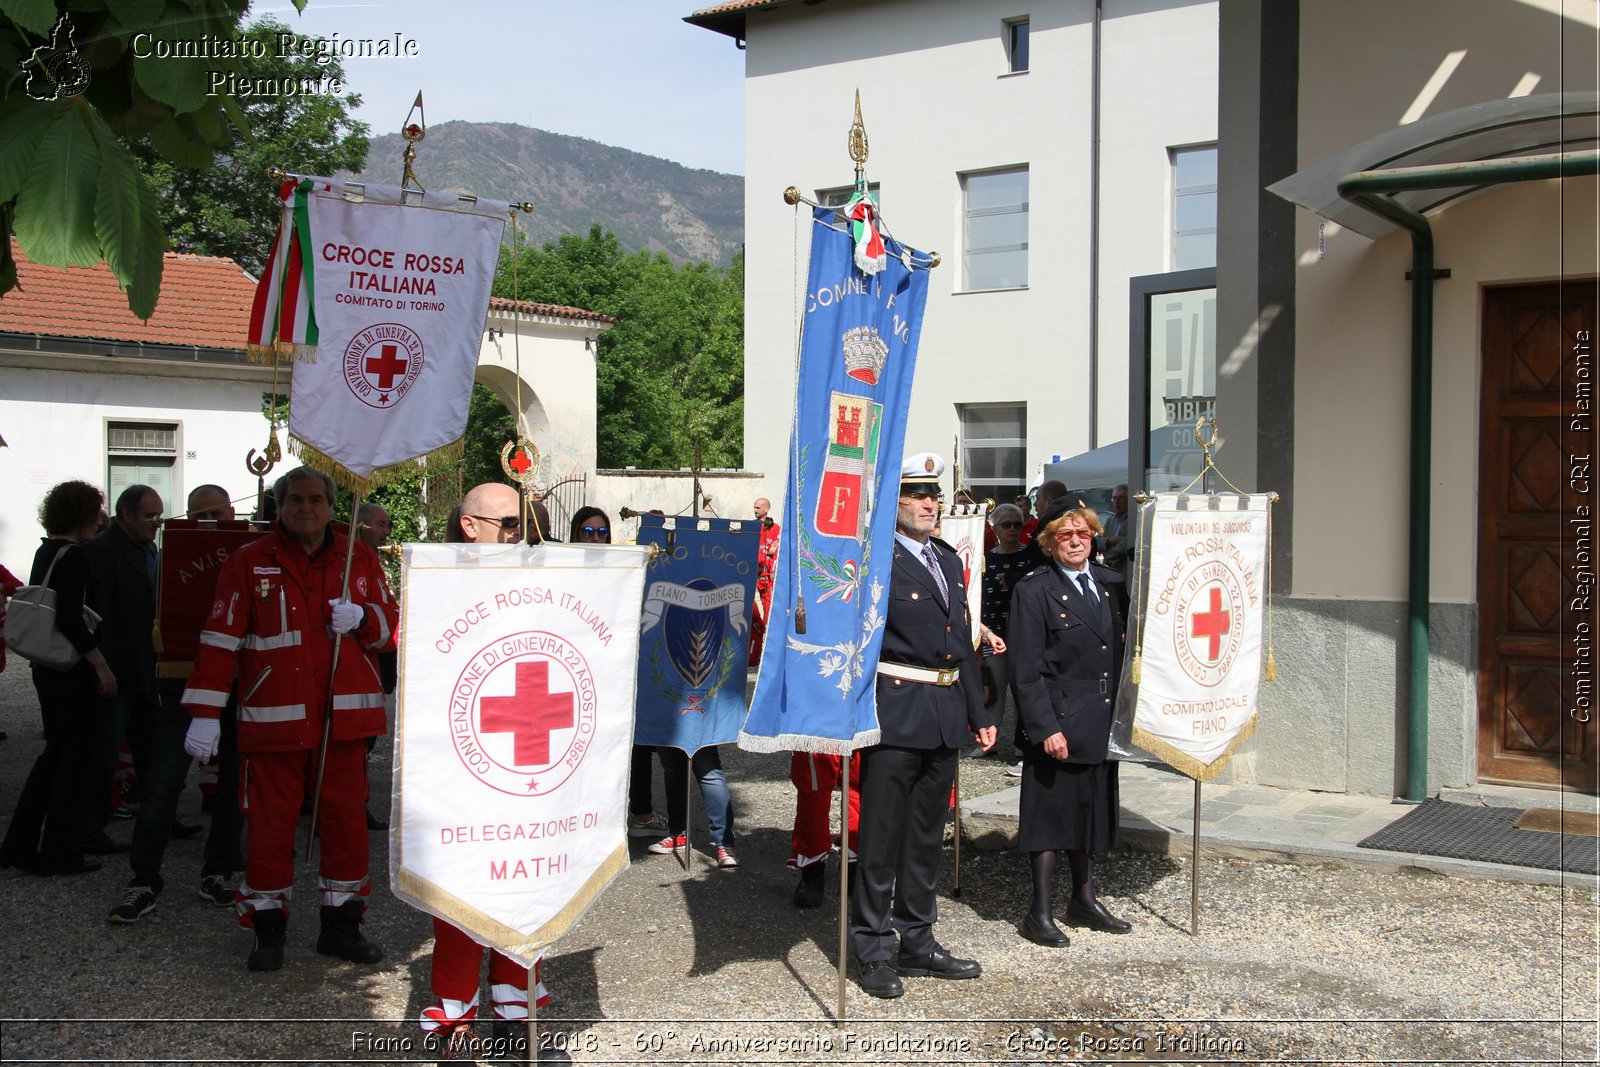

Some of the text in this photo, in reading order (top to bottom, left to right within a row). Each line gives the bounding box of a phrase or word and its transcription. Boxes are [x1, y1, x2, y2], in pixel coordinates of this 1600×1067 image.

[322, 243, 465, 275] CROCE ROSSA
[349, 271, 436, 296] ITALIANA
[335, 293, 445, 312] COMITATO DI TORINO
[346, 339, 372, 397] CONVENZIONE
[362, 331, 375, 344] DI
[375, 326, 412, 344] GINEVRA
[408, 351, 422, 381] AGOSTO
[828, 486, 851, 523] F
[1171, 522, 1209, 535] VOLONTARI
[649, 544, 750, 575] PRO LOCO
[1155, 557, 1185, 615] CROCE
[1185, 537, 1224, 562] ROSSA
[1187, 576, 1199, 591] DI
[655, 586, 740, 607] FIANO TORINESE
[1230, 585, 1239, 600] 22
[435, 587, 613, 654] CROCE ROSSA ITALIANA
[1229, 605, 1242, 653] AGOSTO
[1175, 595, 1207, 681] CONVENZIONE
[453, 636, 593, 775] CONVENZIONE DI GINEVRA 22 AGOSTO 1864
[1162, 695, 1248, 716] COMITATO LOCALE
[1192, 716, 1227, 738] FIANO
[441, 812, 598, 845] DELEGAZIONE DI
[490, 854, 568, 881] MATHI
